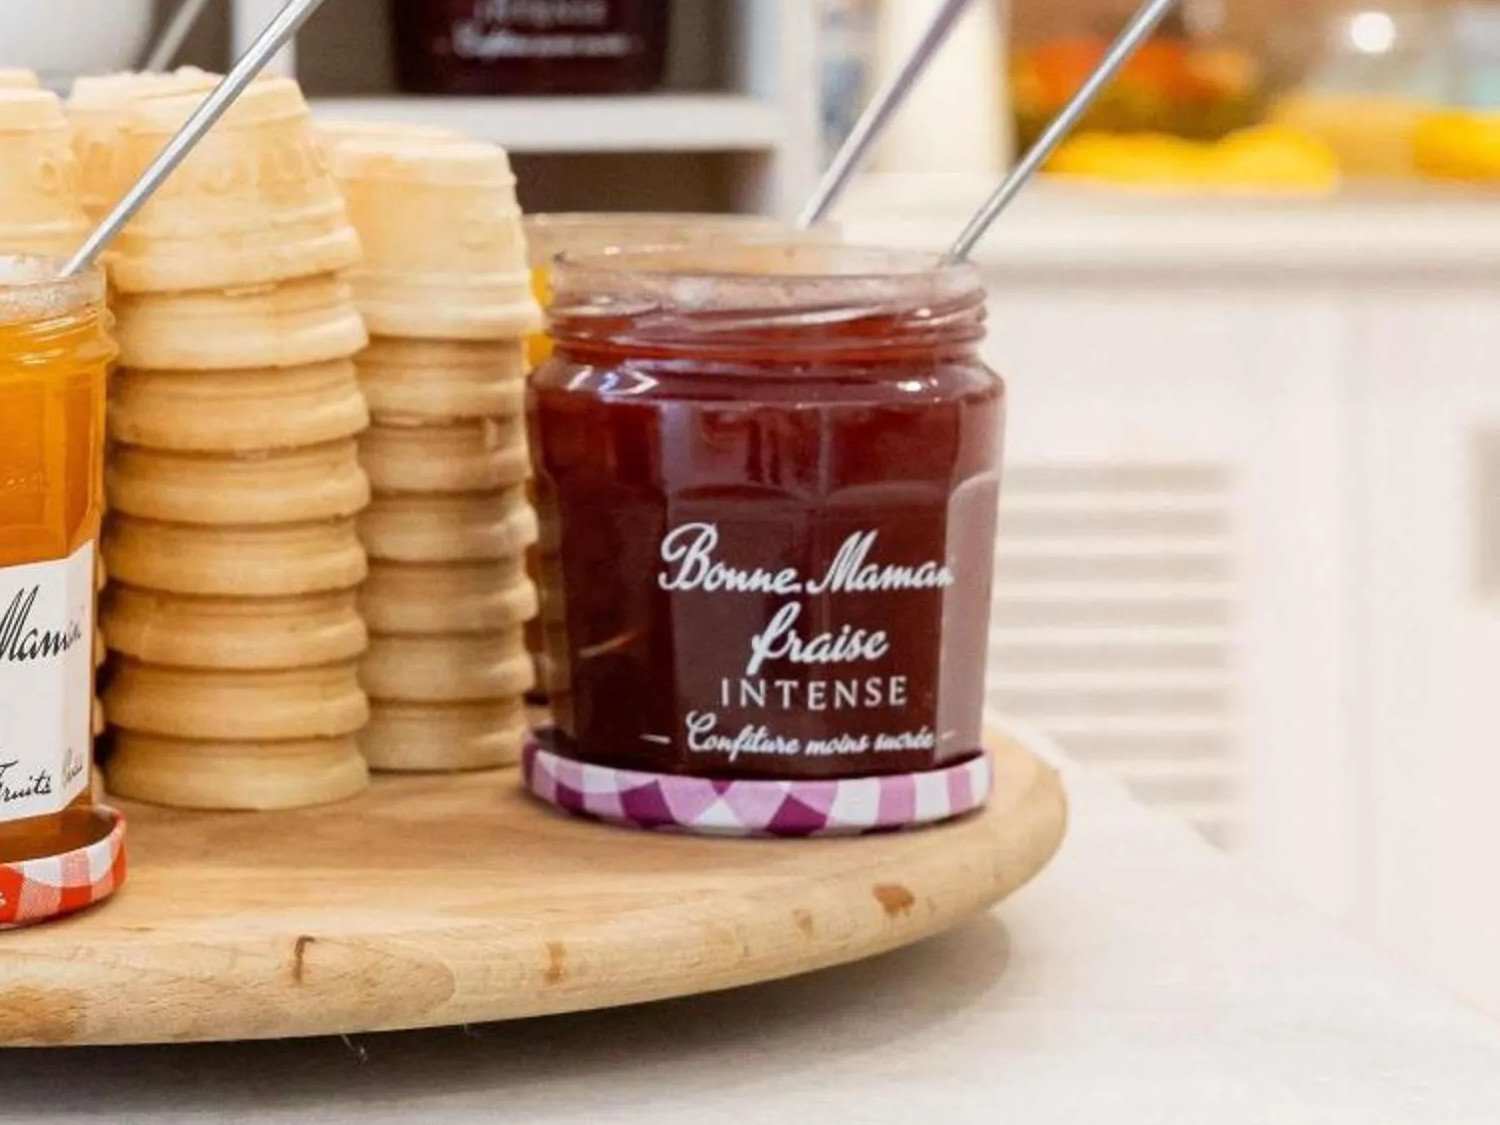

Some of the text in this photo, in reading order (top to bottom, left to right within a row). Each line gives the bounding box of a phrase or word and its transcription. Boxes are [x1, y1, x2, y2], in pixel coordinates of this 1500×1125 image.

[658, 521, 956, 595] Bonne Maman
[746, 600, 890, 675] fraise
[720, 675, 908, 711] INTENSE
[685, 709, 936, 763] Confiture moins sucrée
